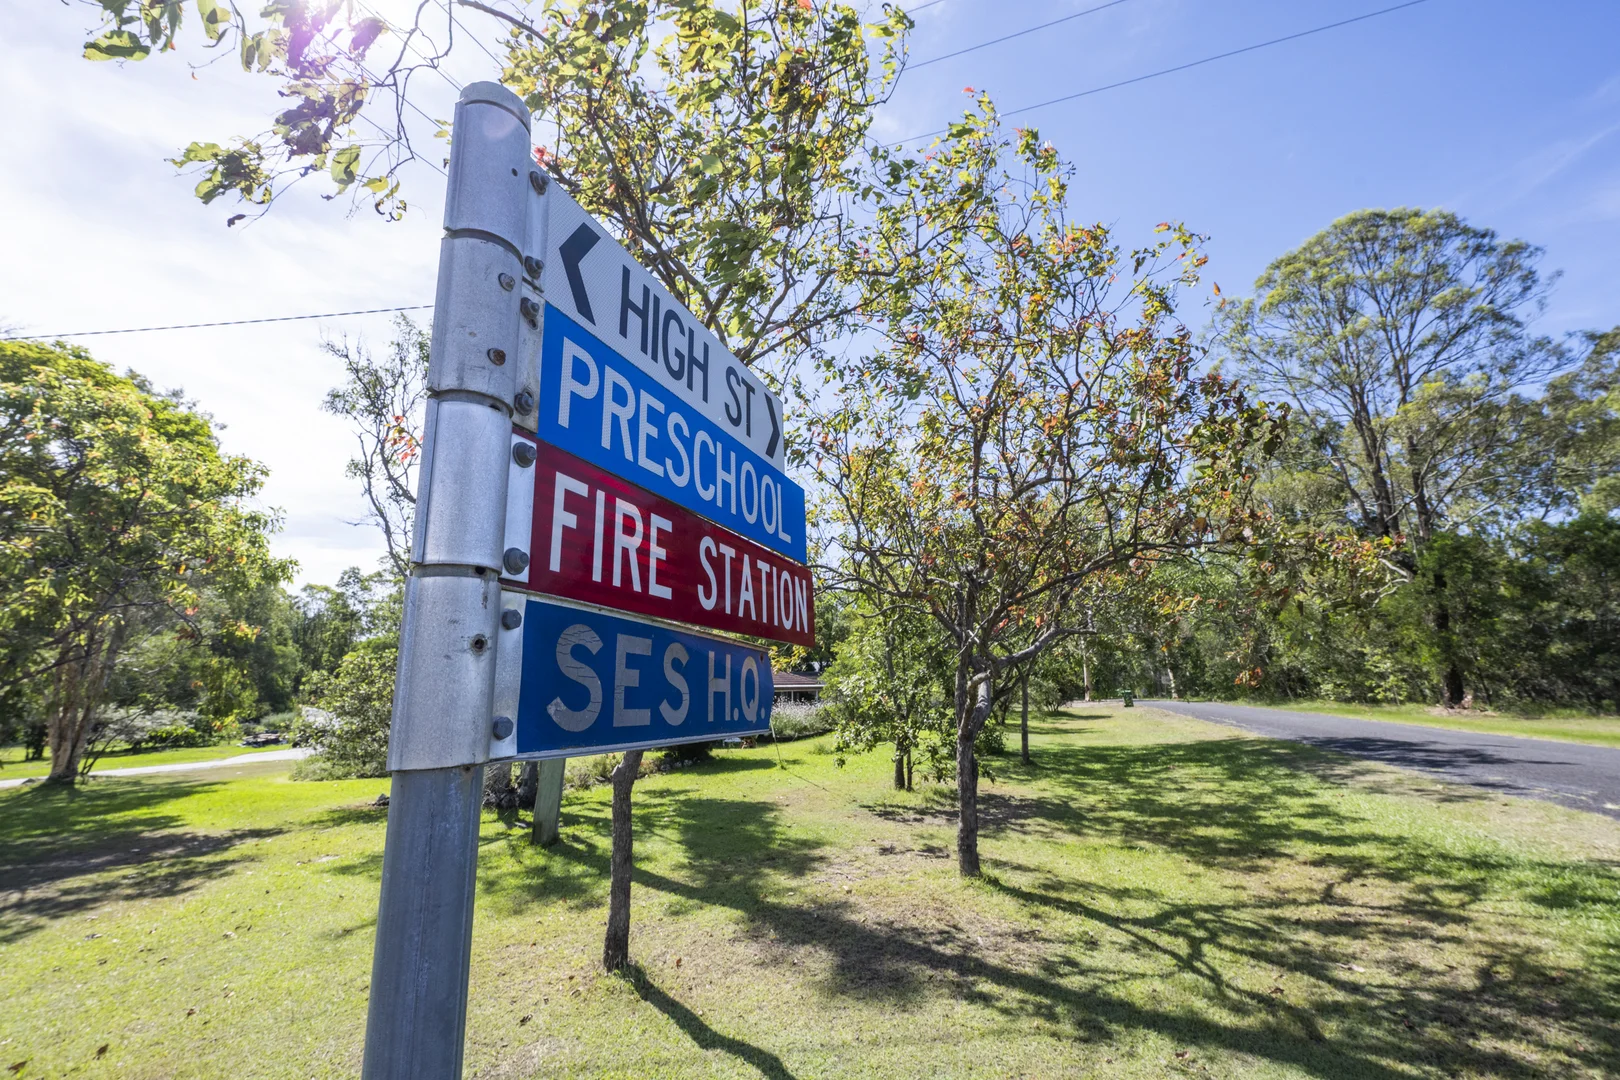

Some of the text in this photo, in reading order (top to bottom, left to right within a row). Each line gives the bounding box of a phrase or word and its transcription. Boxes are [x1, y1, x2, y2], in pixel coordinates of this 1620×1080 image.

[619, 264, 756, 438] HIGH ST
[557, 336, 792, 544] PRESCHOOL
[549, 471, 809, 634] FIRE STATION
[546, 623, 766, 732] SES H.Q.
